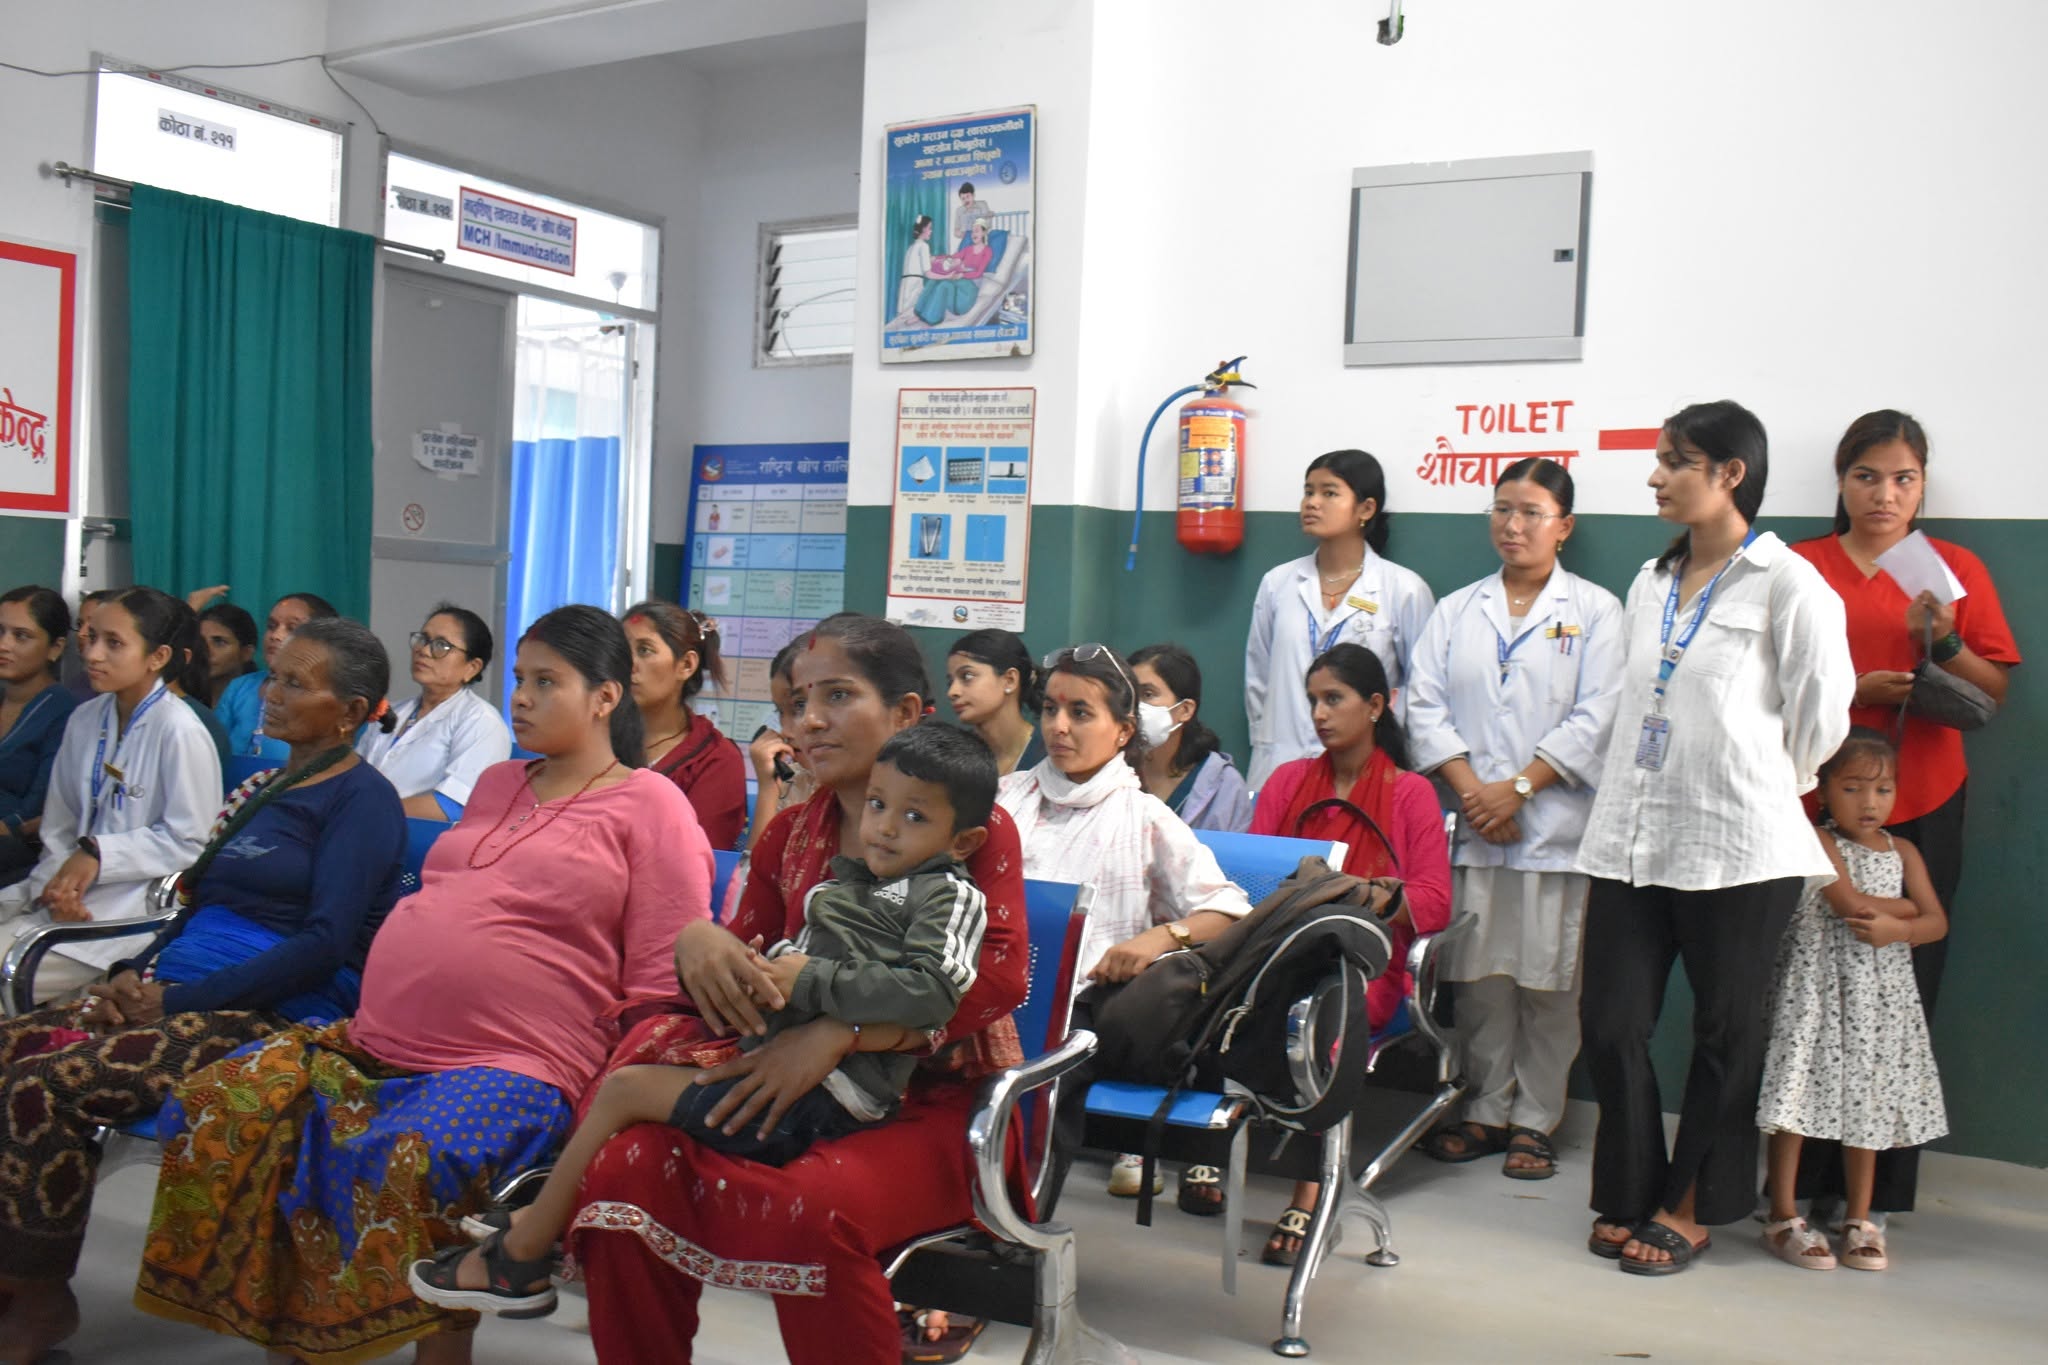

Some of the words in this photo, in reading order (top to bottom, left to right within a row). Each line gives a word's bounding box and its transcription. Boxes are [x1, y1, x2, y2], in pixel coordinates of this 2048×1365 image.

[160, 114, 190, 137] कोठा
[211, 130, 234, 148] २११
[464, 224, 491, 247] MCH
[1455, 400, 1575, 435] TOILET
[797, 456, 820, 473] खोप
[1416, 436, 1580, 486] शौचा
